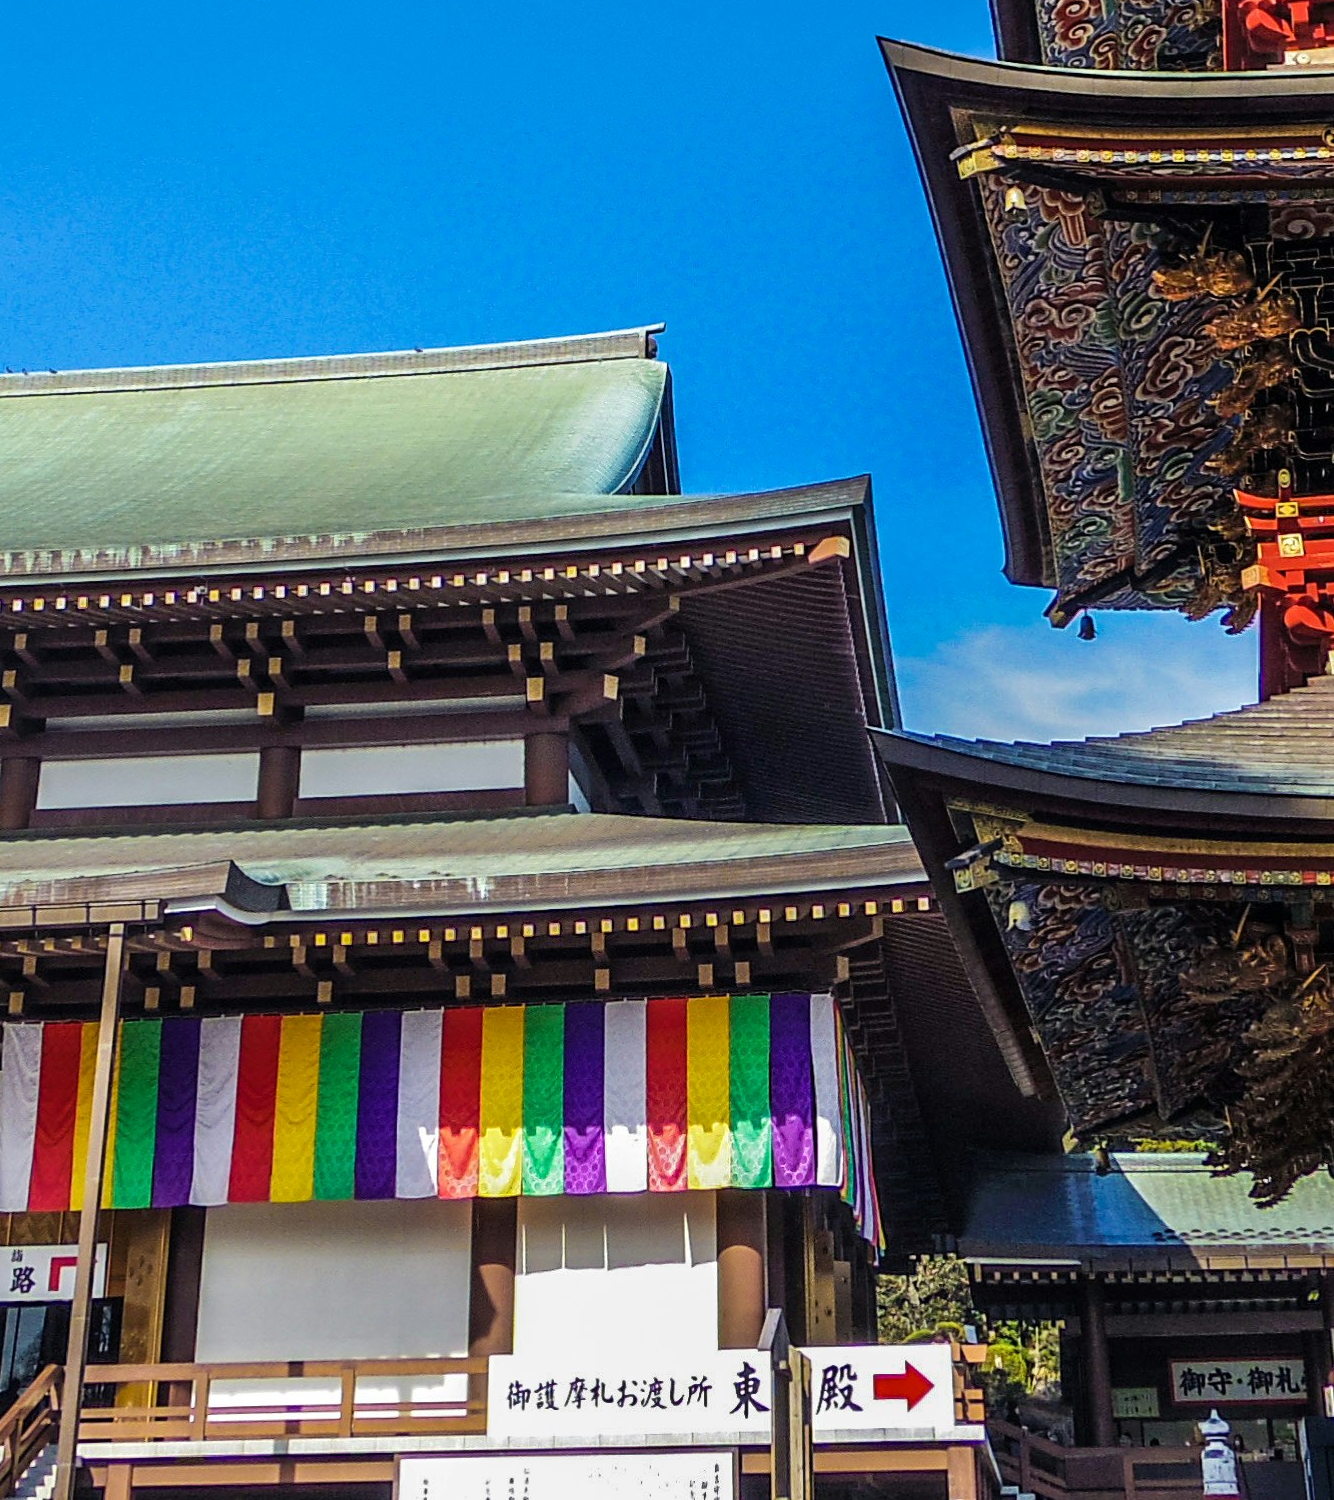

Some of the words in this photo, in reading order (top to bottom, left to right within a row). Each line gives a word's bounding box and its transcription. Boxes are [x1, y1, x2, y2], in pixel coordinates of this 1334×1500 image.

[507, 1375, 713, 1411] 御護摩札お渡し所
[1179, 1366, 1307, 1396] 御守・御札
